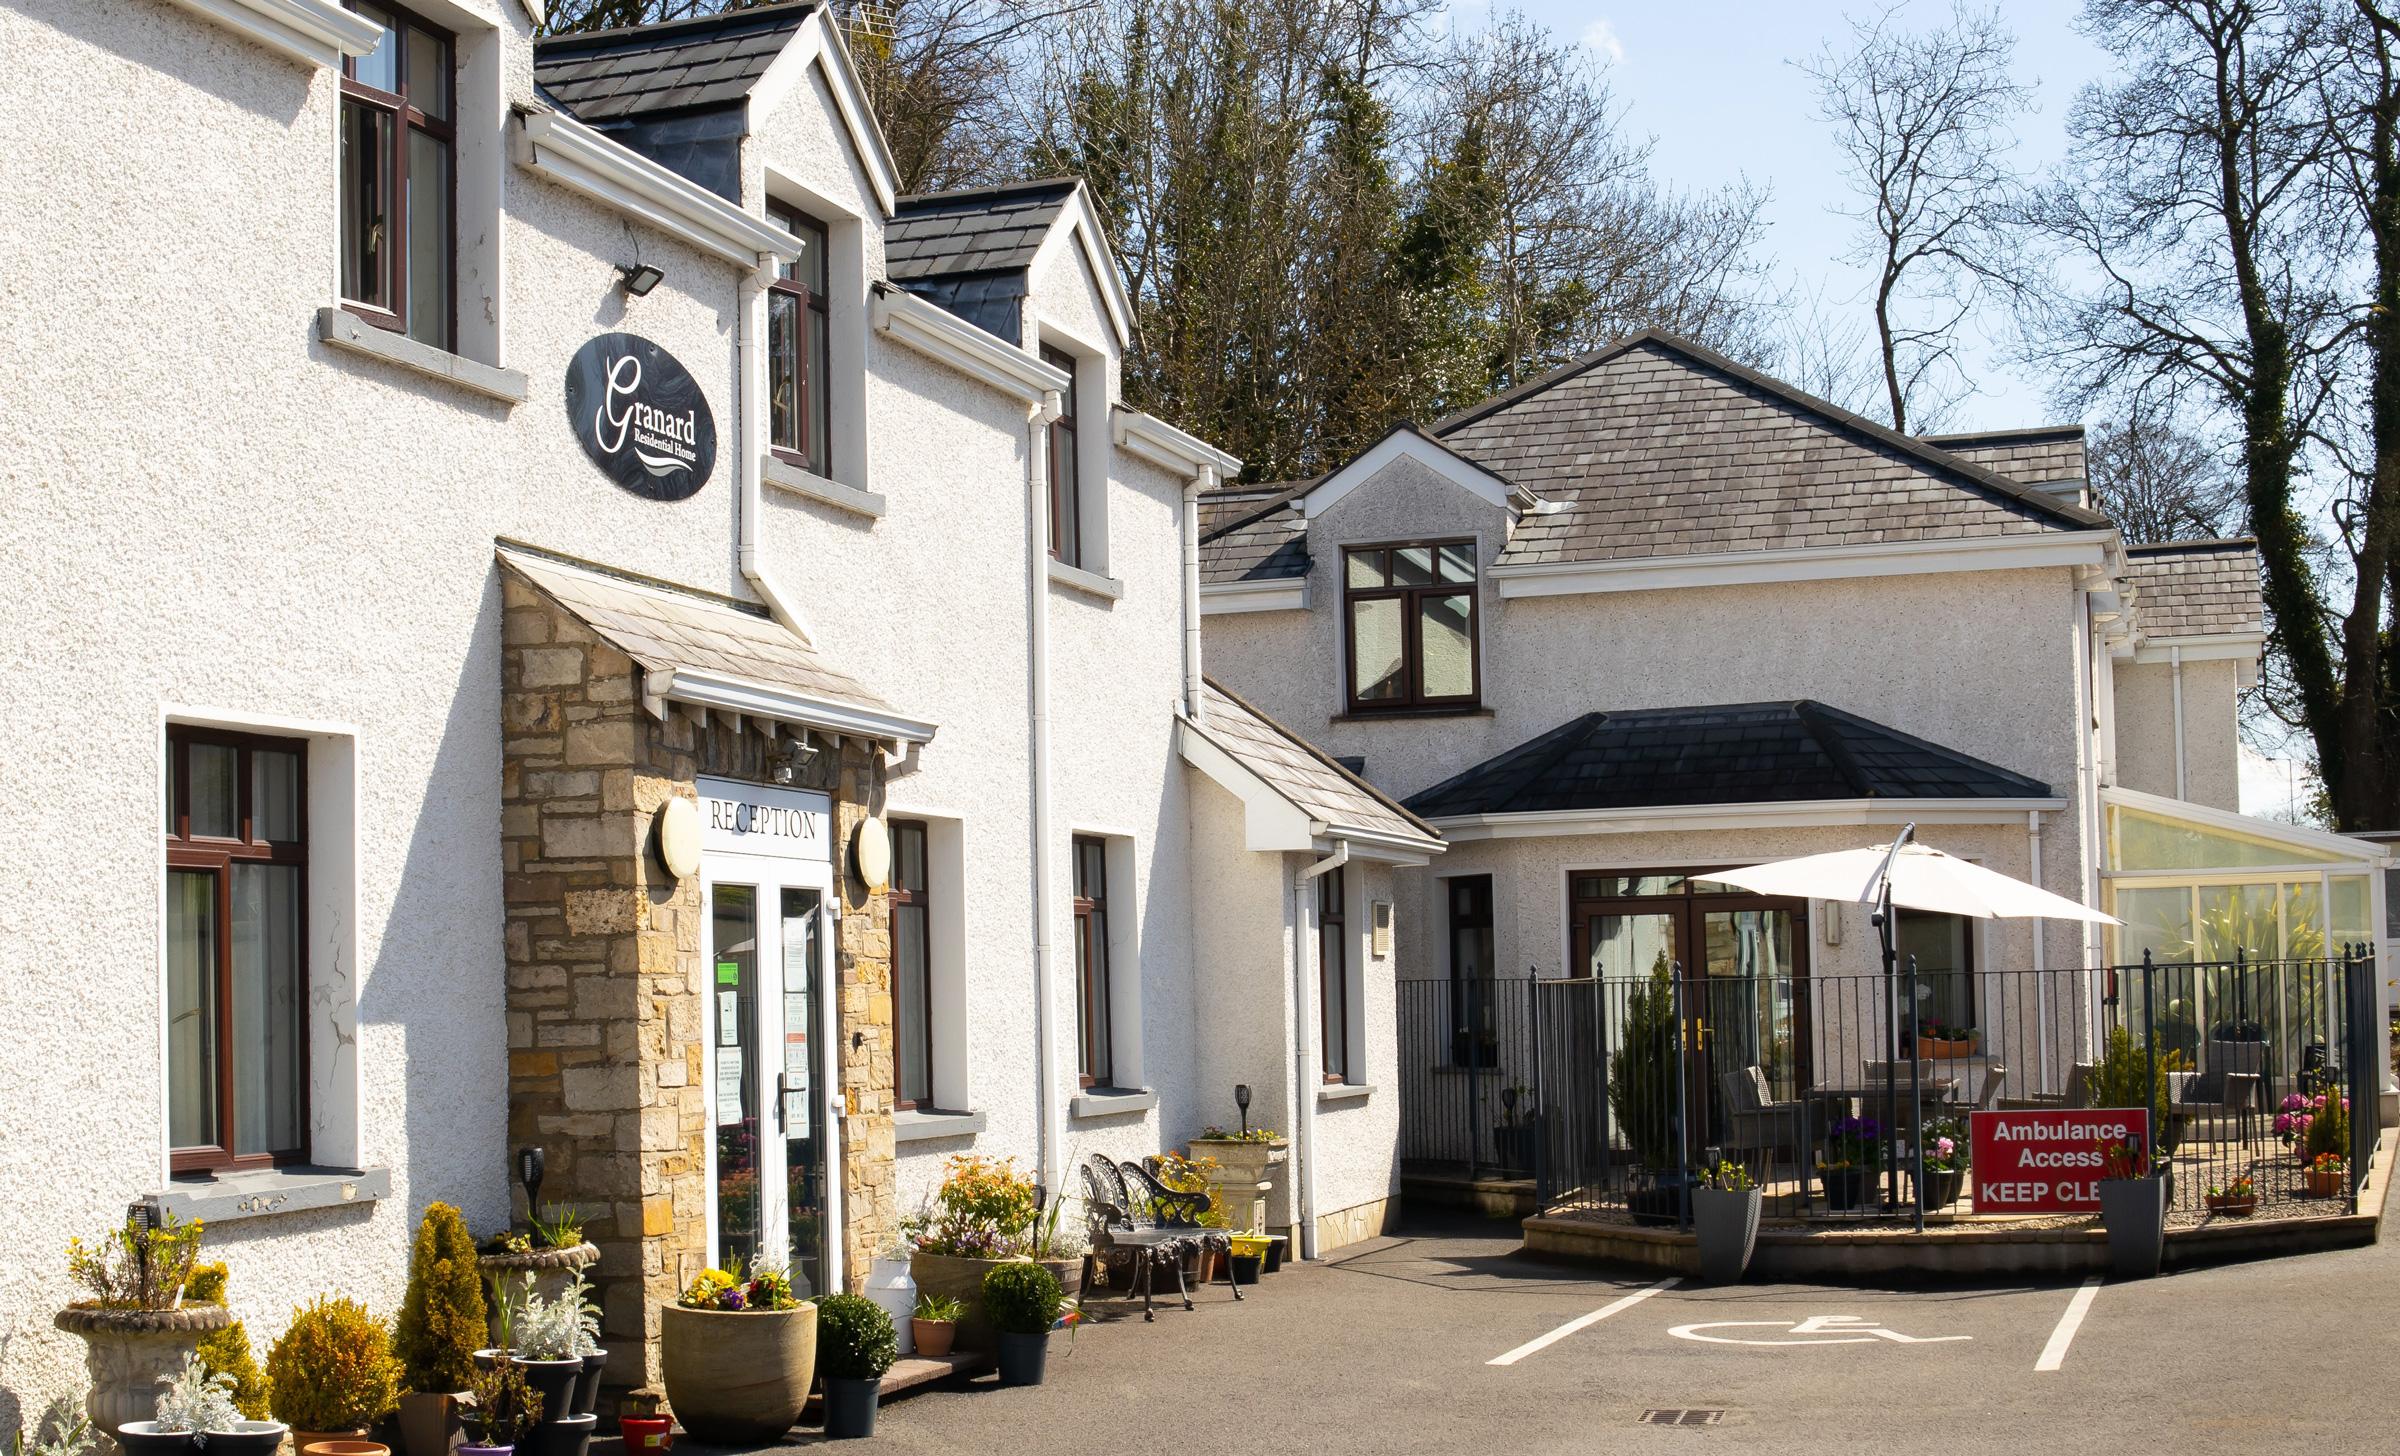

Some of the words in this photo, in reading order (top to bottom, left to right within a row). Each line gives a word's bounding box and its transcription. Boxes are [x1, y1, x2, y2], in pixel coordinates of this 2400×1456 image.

[596, 356, 696, 453] Granard
[634, 427, 674, 454] Residential
[674, 442, 696, 462] Home
[710, 800, 816, 840] RECEPTION
[1993, 1120, 2127, 1142] Ambulance
[2018, 1148, 2104, 1168] Access
[1982, 1182, 2049, 1203] KEEP
[2055, 1181, 2101, 1202] CLE
